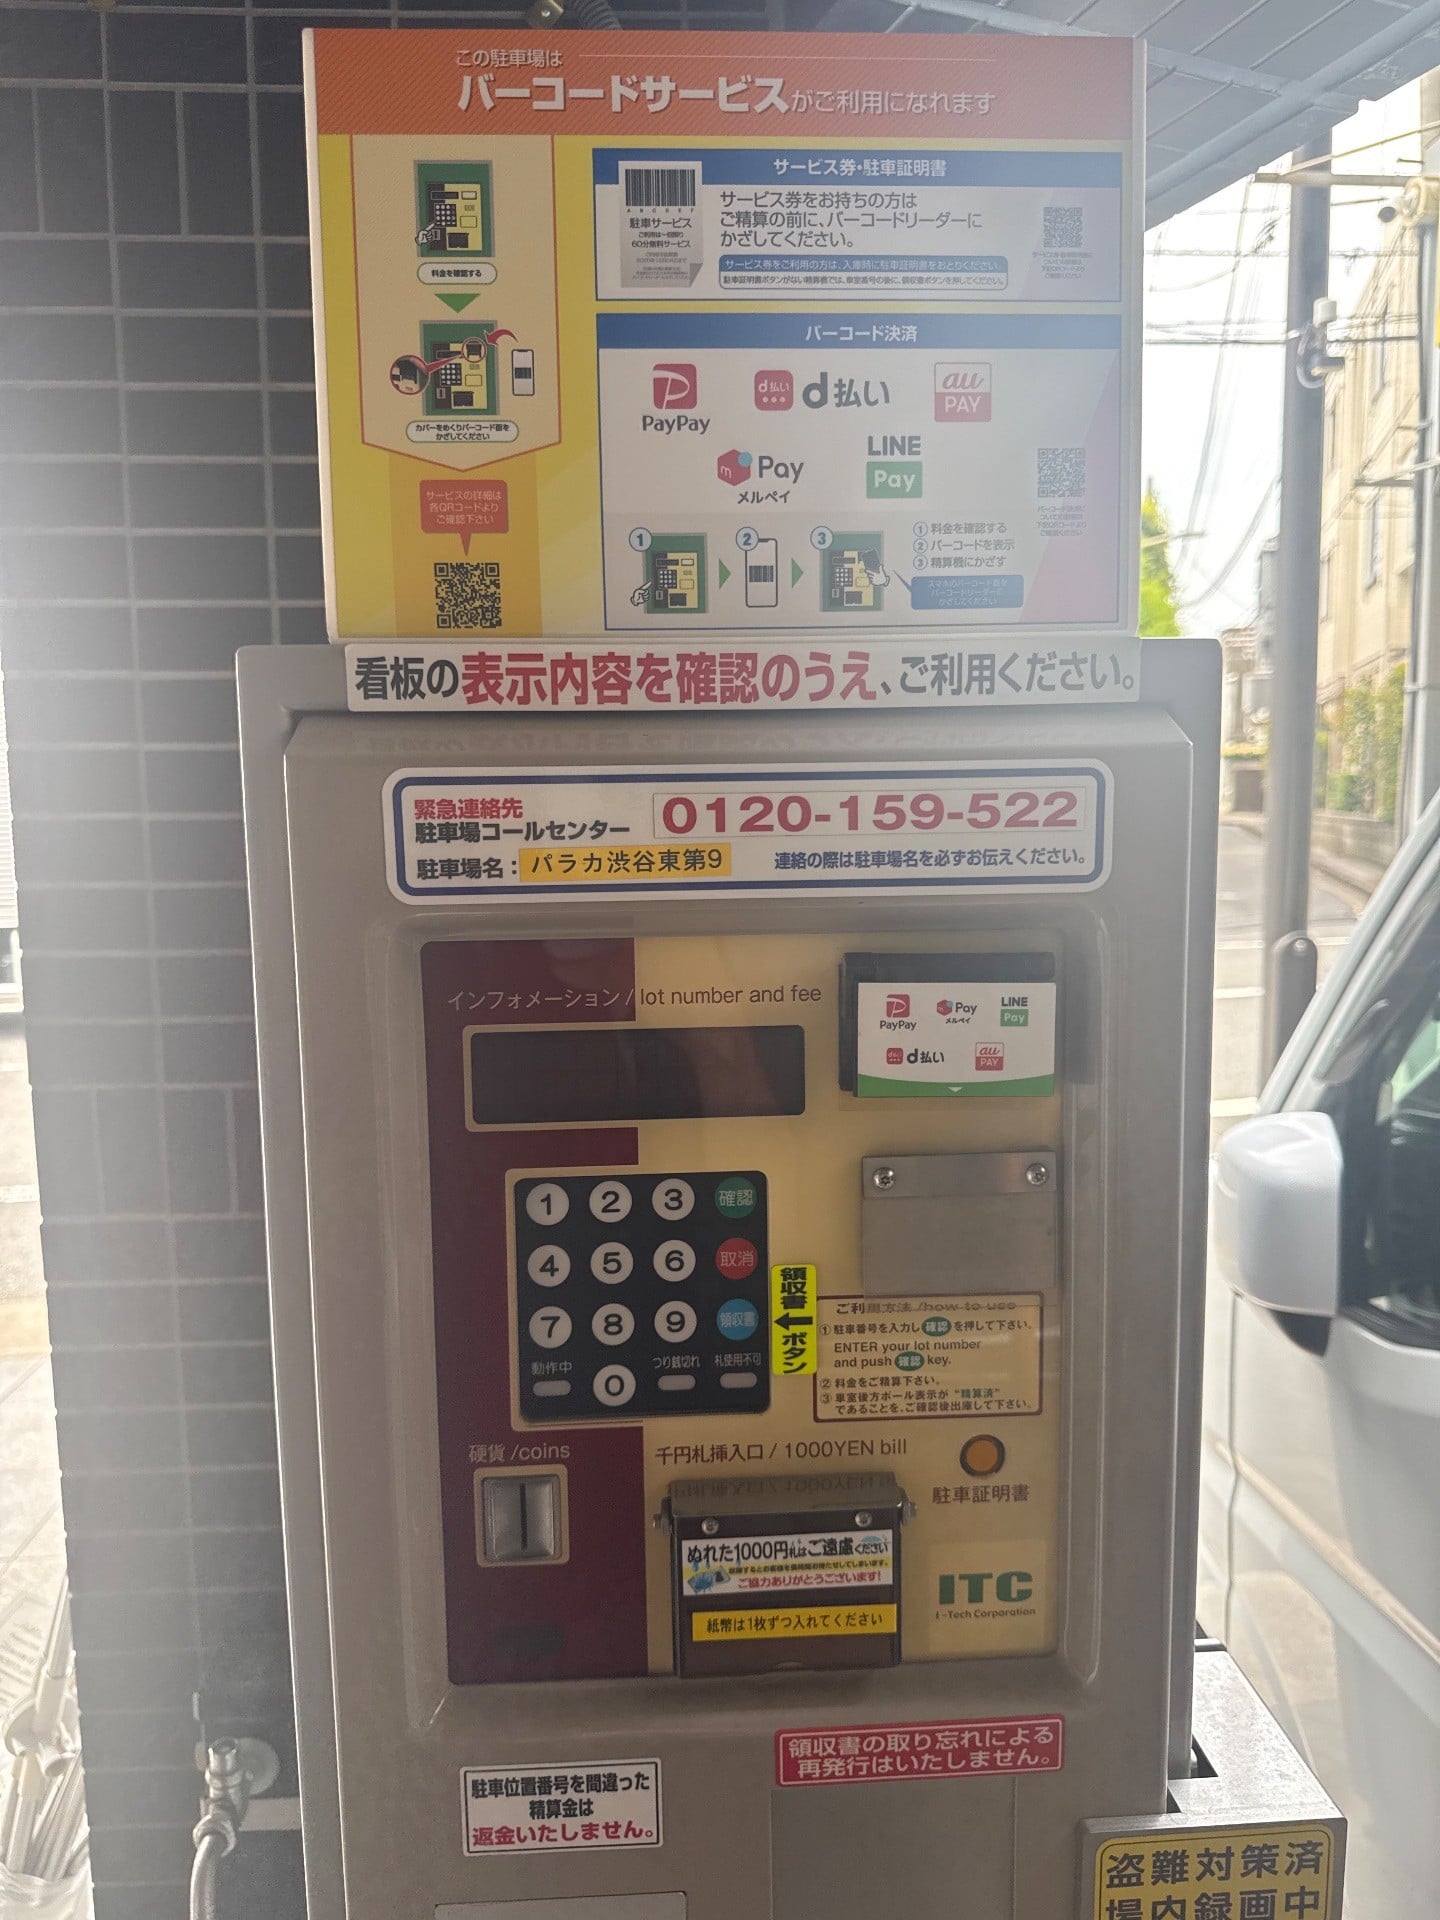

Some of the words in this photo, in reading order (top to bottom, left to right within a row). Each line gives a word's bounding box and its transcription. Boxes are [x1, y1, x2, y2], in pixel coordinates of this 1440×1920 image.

[456, 50, 563, 67] この駐車場は
[719, 191, 918, 210] サービス券をお持ちの方は
[630, 218, 692, 229] 駐車サービス
[720, 211, 983, 229] ご精算の前に、バーコードリーダーに
[719, 230, 855, 248] かざしてください。
[805, 325, 918, 344] バーコード決済
[802, 371, 890, 408] d払い
[941, 370, 985, 390] au
[944, 397, 981, 414] PAY
[642, 415, 710, 435] PayPay
[436, 432, 490, 441] かざしてください
[867, 436, 921, 456] LINE
[758, 455, 804, 484] Pay
[873, 470, 916, 493] Pay
[737, 491, 791, 505] メルペイ
[413, 798, 524, 820] 緊急連絡先
[661, 790, 1078, 835] 0120-159-522
[415, 820, 630, 845] 駐車場コールセンター
[531, 848, 723, 875] パラカ渋谷東第9
[774, 848, 1086, 870] 連絡の際は駐車場名を必ずお伝えください。
[640, 988, 665, 1006] lot
[670, 987, 741, 1005] number
[748, 985, 784, 1004] and
[791, 984, 822, 1002] fee
[1001, 997, 1028, 1007] LINE
[955, 1002, 977, 1015] Pay
[1004, 1013, 1025, 1024] Pay
[880, 1020, 917, 1031] PayPay
[906, 1048, 945, 1064] d払い
[979, 1046, 1000, 1056] au
[980, 1058, 1000, 1067] PAY
[541, 1193, 552, 1216] 1
[601, 1190, 620, 1213] 2
[664, 1188, 683, 1211] 3
[718, 1189, 754, 1207] 確認
[540, 1254, 559, 1277] 4
[602, 1252, 622, 1274] 5
[665, 1250, 684, 1272] 6
[720, 1250, 755, 1267] 取消
[780, 1267, 808, 1310] 領収書
[541, 1316, 560, 1338] 7
[604, 1313, 623, 1336] 8
[666, 1310, 685, 1333] 9
[718, 1311, 756, 1328] 領収書
[834, 1321, 920, 1335] 駐車番号を入力し
[924, 1321, 948, 1332] 確認
[953, 1319, 1032, 1332] を押して下さい。
[782, 1332, 807, 1374] ボタン
[834, 1342, 878, 1353] ENTER
[882, 1343, 910, 1355] your
[914, 1340, 930, 1350] lot
[934, 1340, 982, 1350] number
[531, 1360, 572, 1376] 動作中
[652, 1354, 701, 1369] つり銭切れ
[714, 1352, 762, 1368] 札使用不可
[834, 1357, 857, 1368] and
[861, 1356, 892, 1370] push
[928, 1354, 952, 1368] key.
[604, 1374, 624, 1397] 0
[468, 1444, 506, 1464] 硬貨
[655, 1444, 764, 1466] 千円札挿入口
[785, 1438, 874, 1458] 1000YEN
[880, 1438, 907, 1456] bill
[932, 1484, 1030, 1505] 駐車証明書
[939, 1570, 1033, 1605] ITC
[706, 1612, 883, 1634] 紙幣は1枚ずつ入れてください
[974, 1608, 1036, 1619] Corporation
[788, 1726, 1054, 1758] 領収書の取り忘れによる
[798, 1749, 1051, 1778] 再発行はいたしません。
[471, 1772, 651, 1799] 駐車位置番号を間違った
[529, 1799, 595, 1820] 精算金は
[472, 1820, 654, 1847] 返金いたしません。
[1106, 1840, 1324, 1889] 盗難対策済
